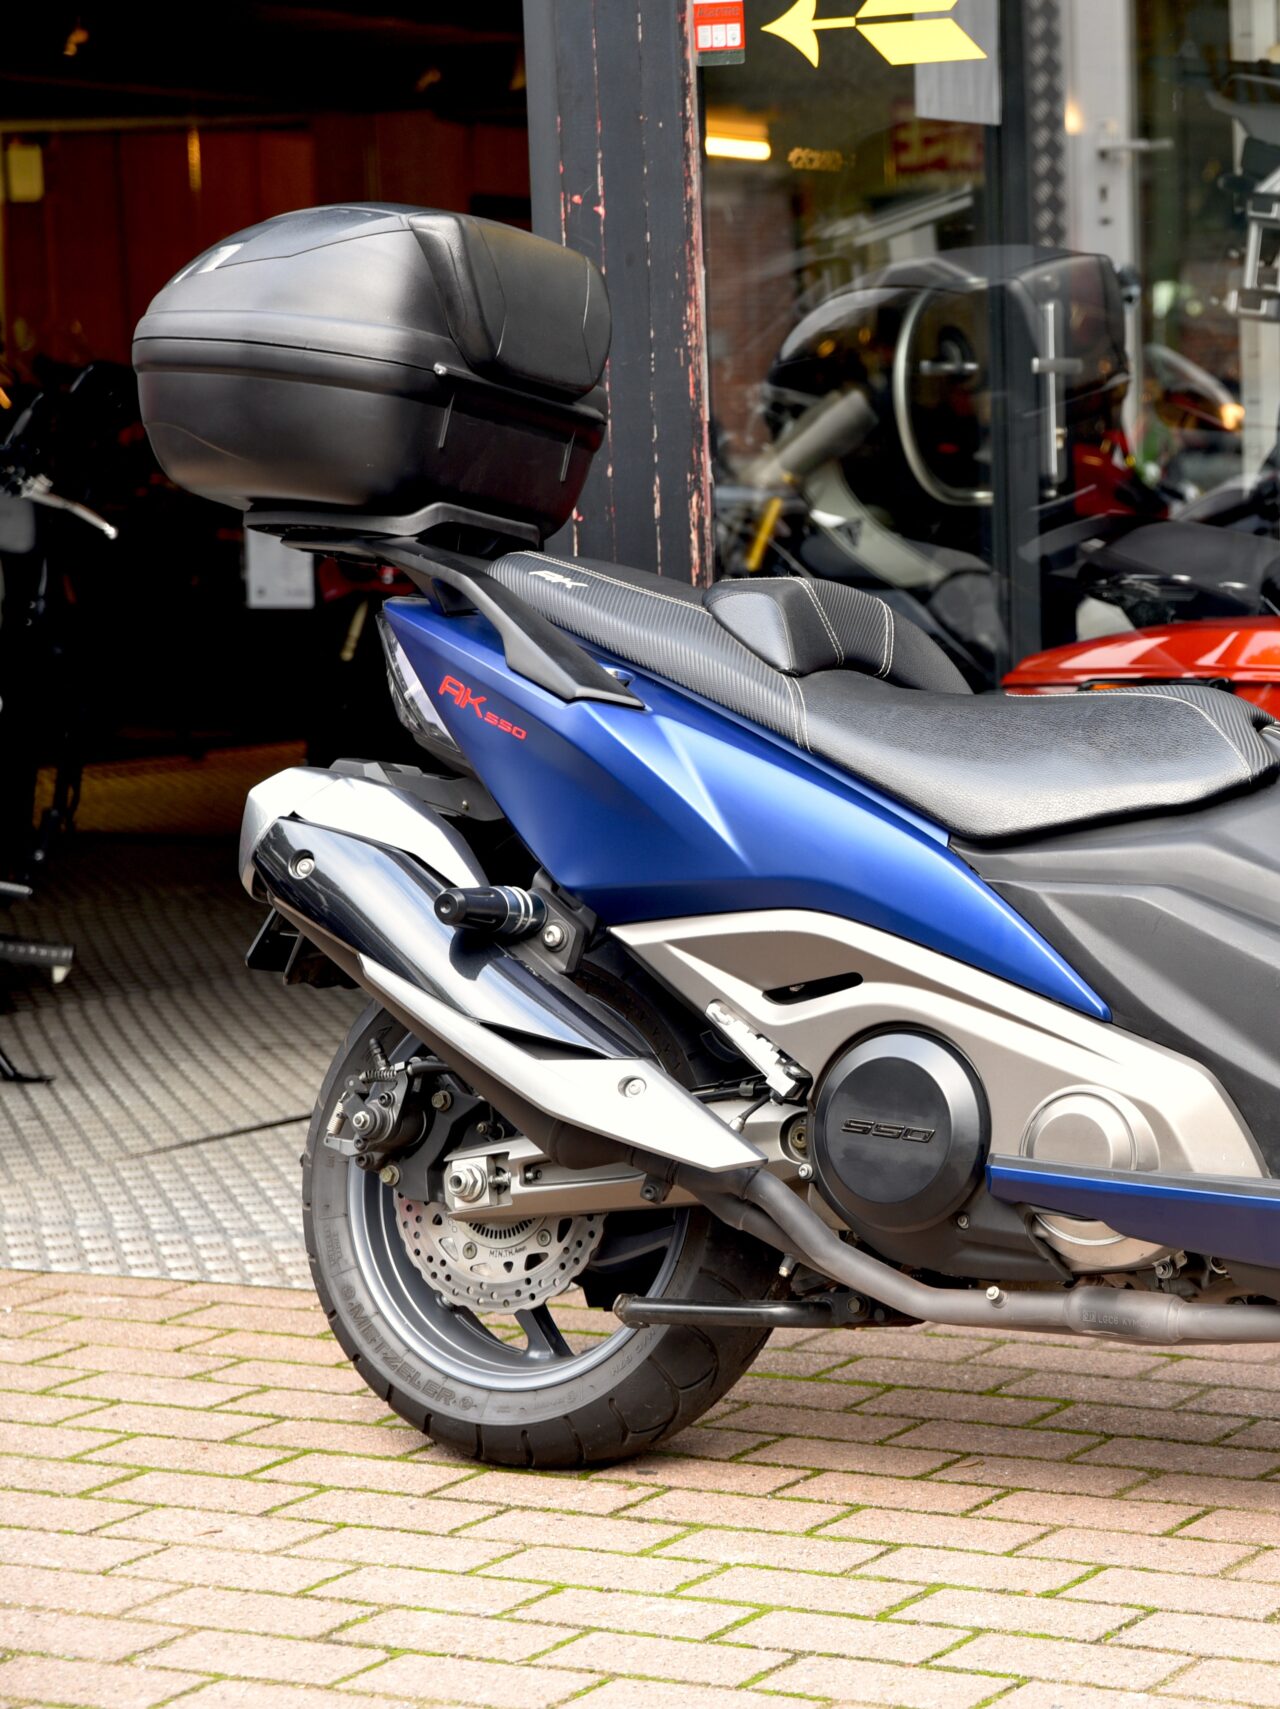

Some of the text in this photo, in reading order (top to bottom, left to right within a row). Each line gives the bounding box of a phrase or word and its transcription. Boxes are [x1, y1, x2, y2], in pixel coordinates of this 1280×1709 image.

[438, 674, 527, 740] AK 550
[348, 1301, 457, 1407] METZELER
